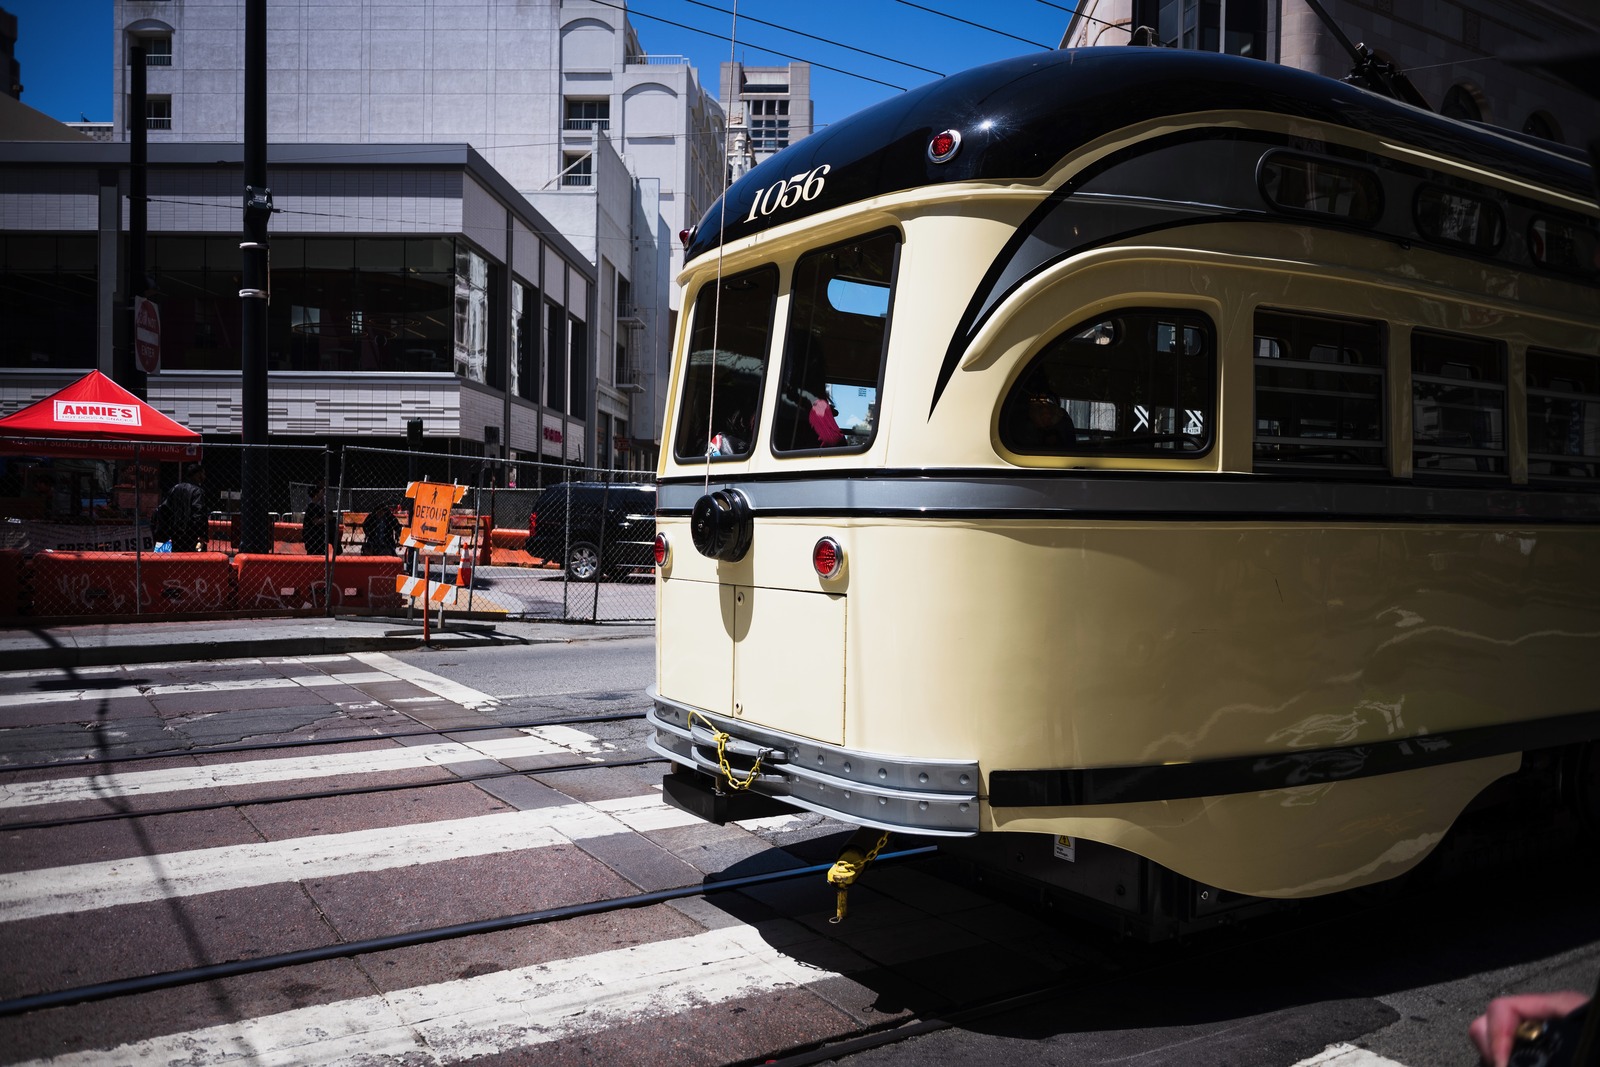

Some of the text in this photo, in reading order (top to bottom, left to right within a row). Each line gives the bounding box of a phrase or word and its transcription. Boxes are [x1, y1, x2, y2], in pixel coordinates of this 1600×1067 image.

[743, 164, 831, 224] 1056
[141, 344, 155, 358] ENTER
[62, 404, 133, 419] ANNIE'S
[415, 504, 448, 522] DETOUR
